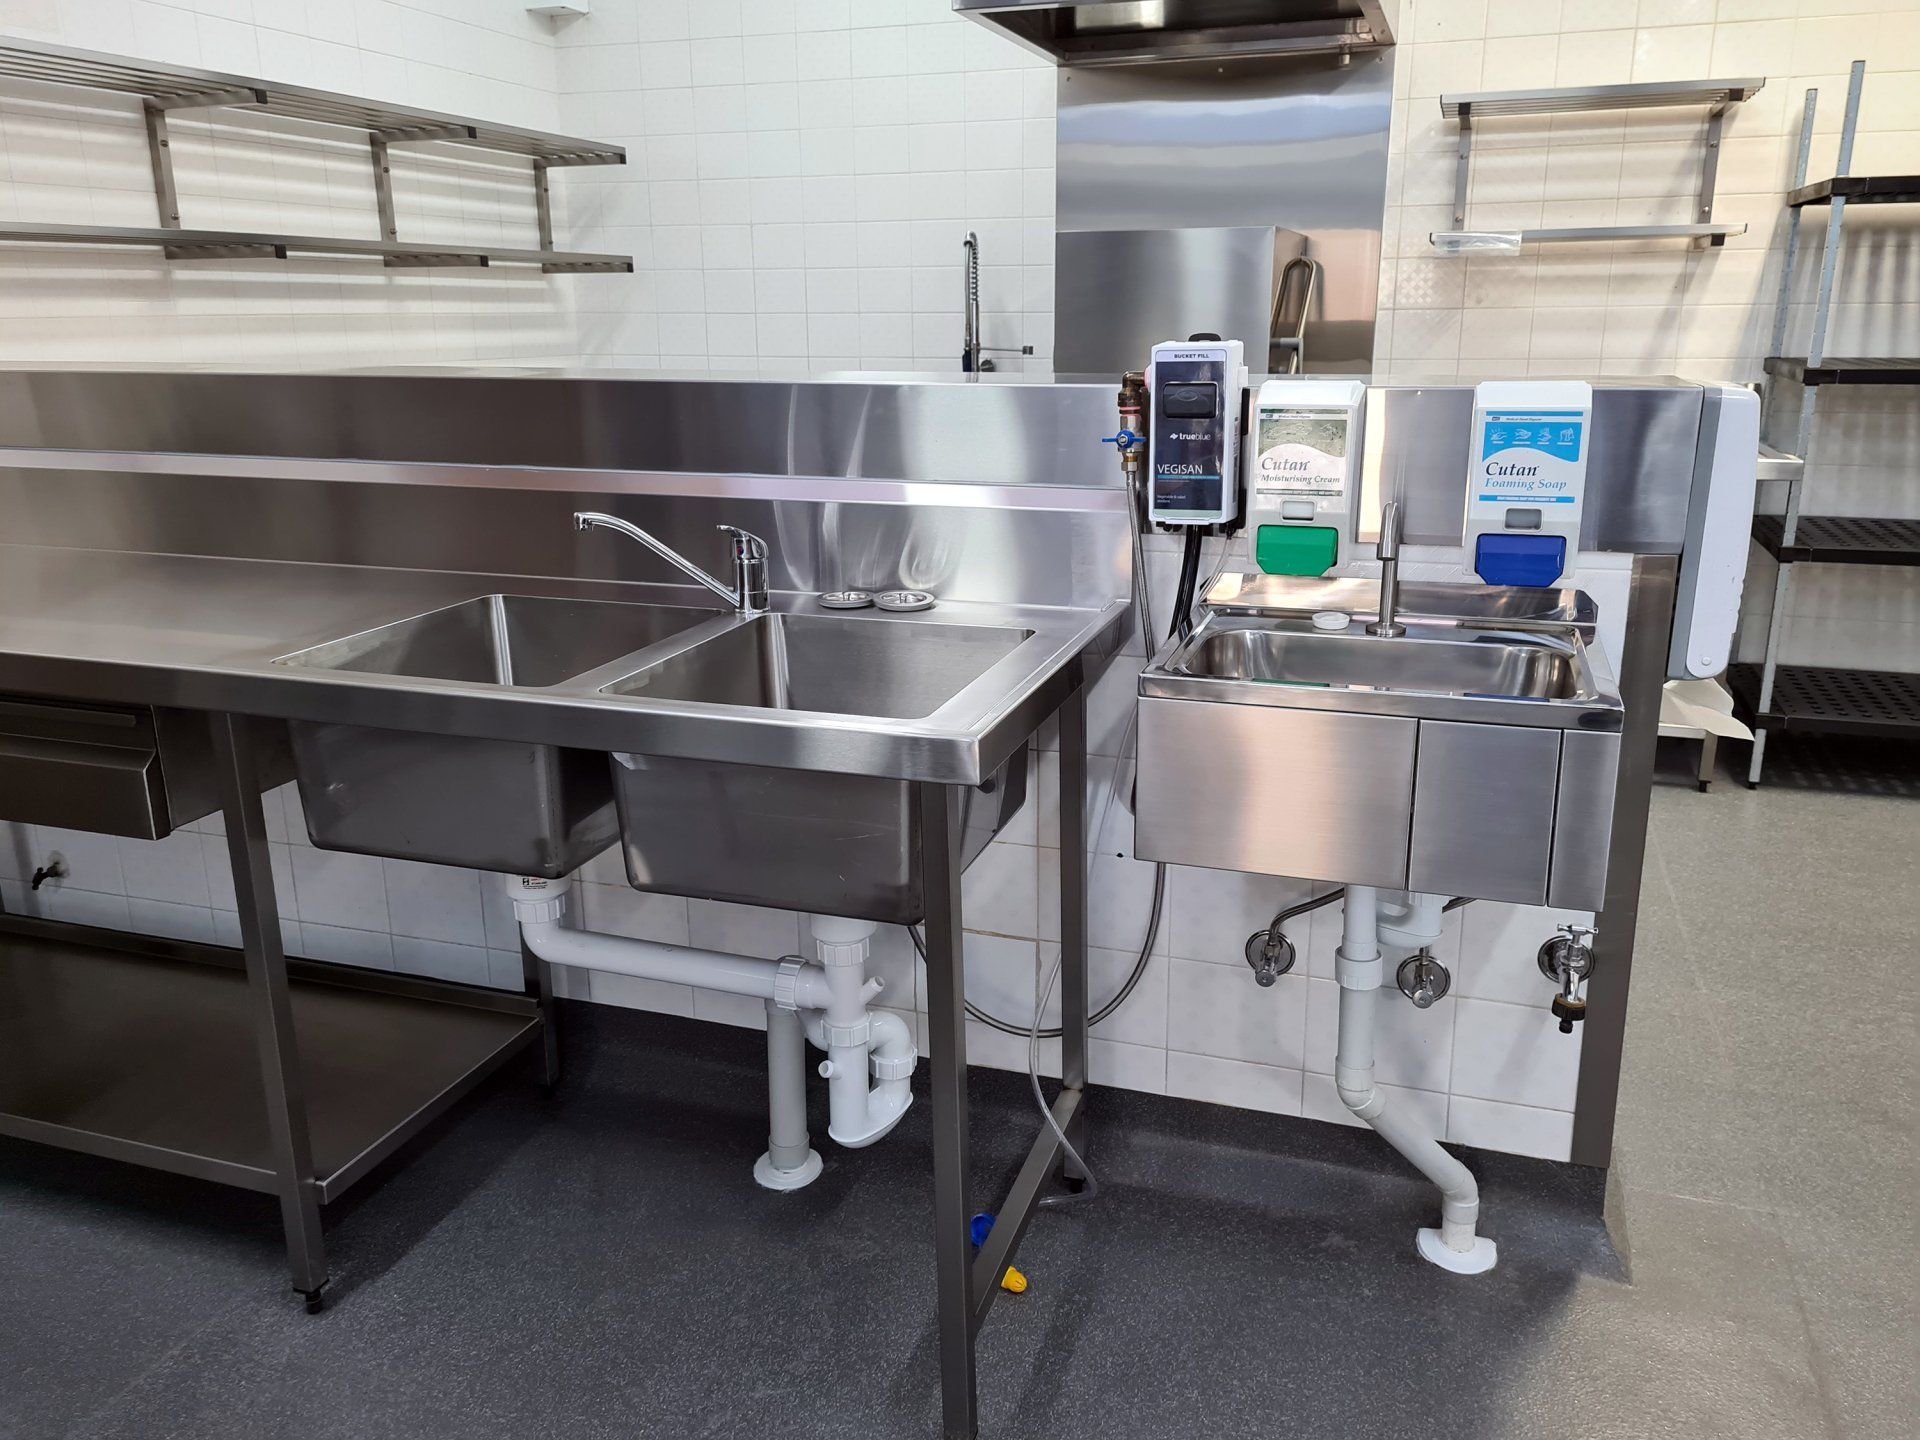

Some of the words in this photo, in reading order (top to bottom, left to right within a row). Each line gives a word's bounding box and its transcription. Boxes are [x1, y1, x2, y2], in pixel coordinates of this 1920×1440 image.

[1157, 464, 1203, 474] VEGISAN
[1261, 457, 1309, 471] Cutan
[1486, 461, 1538, 476] Cutan
[1261, 475, 1312, 485] Moisturising
[1485, 477, 1535, 491] Foaming
[1538, 479, 1567, 491] Soap
